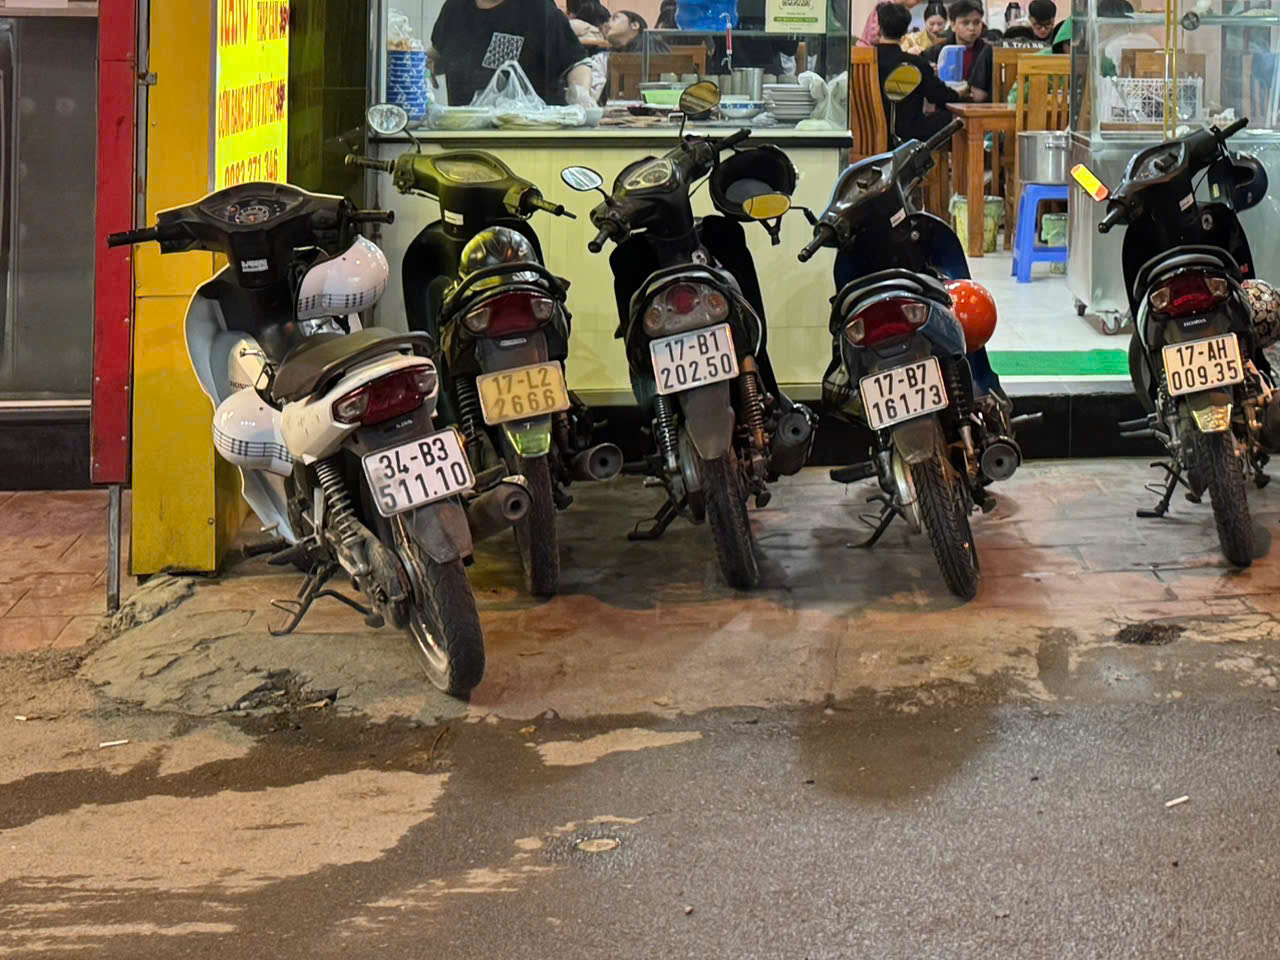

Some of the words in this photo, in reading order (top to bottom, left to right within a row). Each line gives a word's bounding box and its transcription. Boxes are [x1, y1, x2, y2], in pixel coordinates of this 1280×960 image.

[664, 330, 720, 363] 17-B1
[1176, 338, 1228, 367] 17-AH
[492, 367, 551, 396] 17-L2
[660, 353, 732, 389] 202.50
[874, 363, 926, 398] 17-B7
[1171, 360, 1238, 391] 009.35
[491, 388, 556, 419] 2666
[872, 384, 942, 424] 161.73
[379, 437, 449, 480] 34-B3
[380, 461, 468, 510] 511.10
